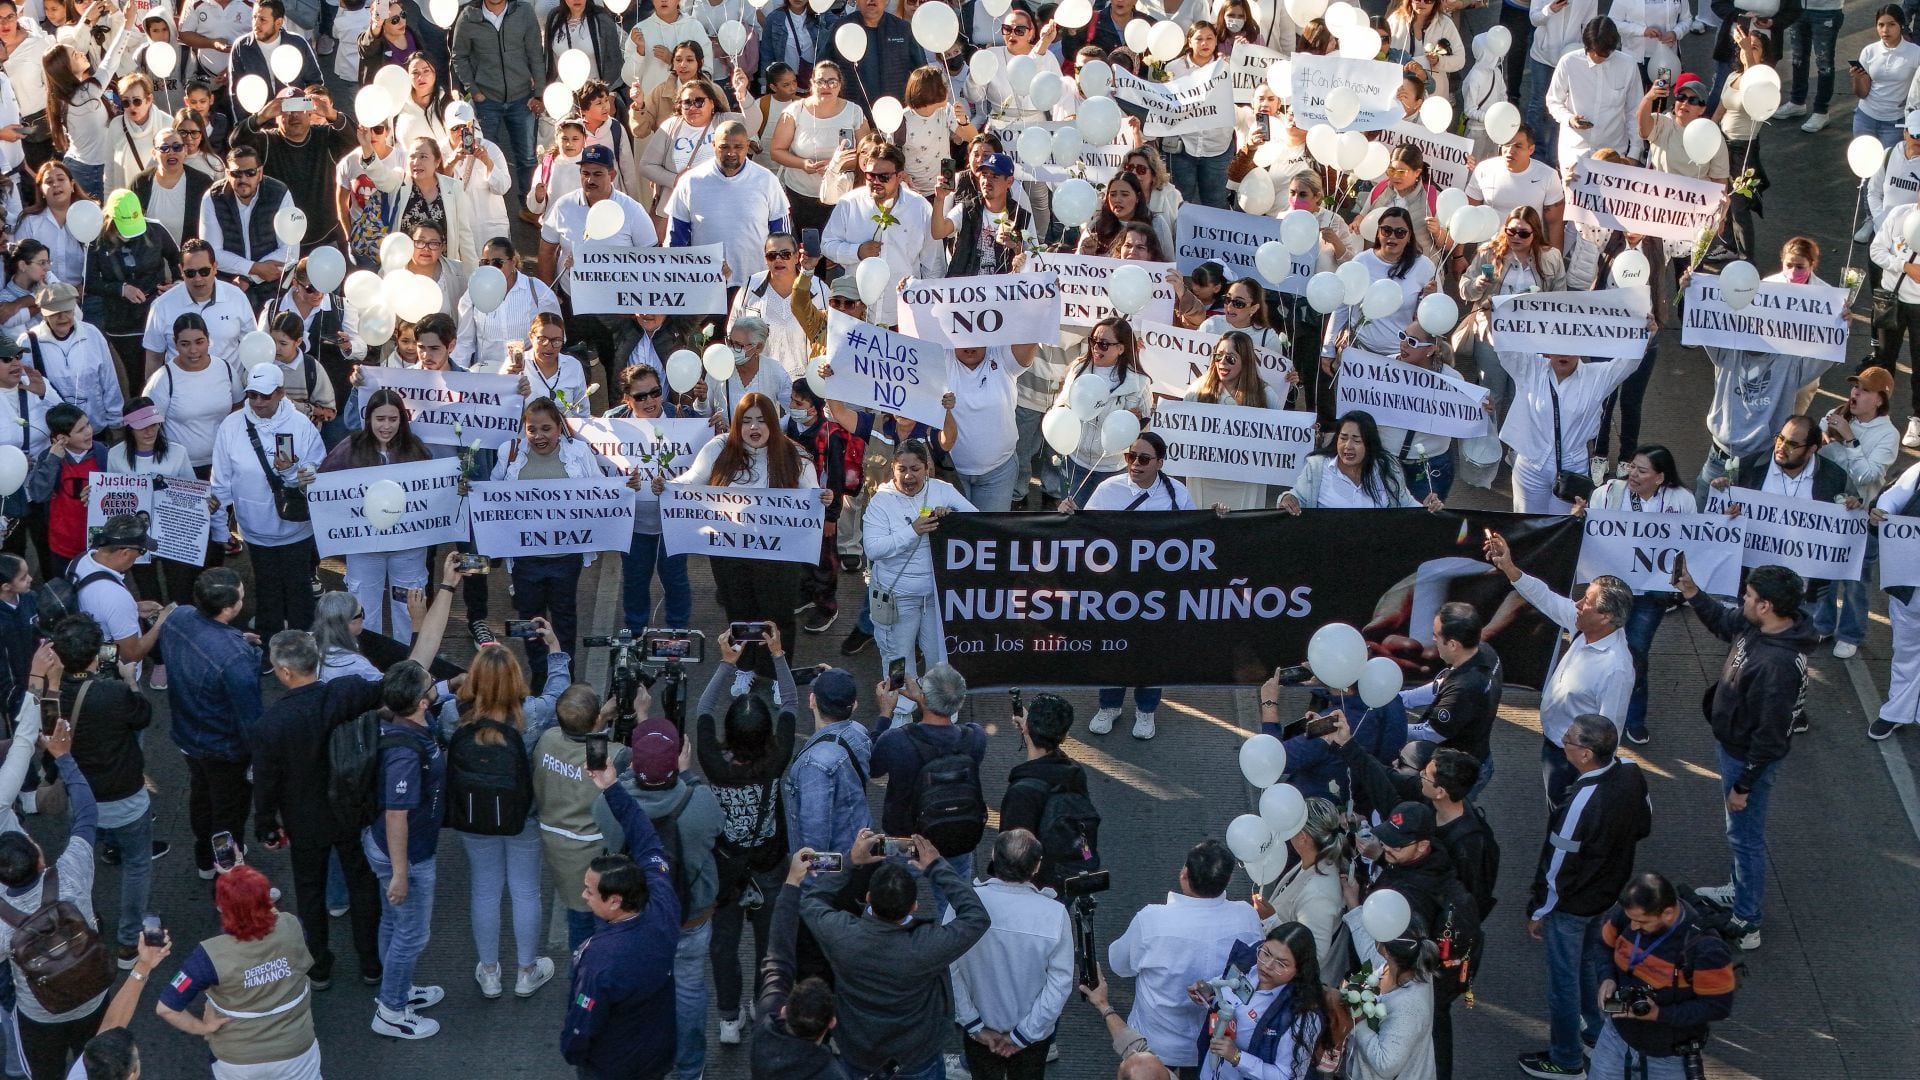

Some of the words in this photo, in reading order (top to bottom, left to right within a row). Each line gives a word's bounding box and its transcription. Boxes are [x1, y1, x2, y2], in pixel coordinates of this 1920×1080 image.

[1242, 56, 1283, 68] JUST
[1141, 97, 1164, 110] NOS
[1378, 129, 1396, 146] DE
[1086, 153, 1102, 167] SIN
[1102, 154, 1121, 168] VID
[1584, 172, 1660, 197] JUSTICIA
[1664, 187, 1707, 206] PARA
[1890, 176, 1918, 192] PUMA
[1568, 188, 1639, 220] ALEXANDER
[1642, 204, 1716, 229] SARMIENTO
[1192, 225, 1259, 247] JUSTICIA
[583, 253, 610, 264] LOS
[613, 252, 656, 264] NIÑOS
[656, 255, 667, 264] Y
[670, 254, 711, 265] NIÑAS
[1180, 245, 1215, 259] GAEL
[573, 271, 639, 282] MERECEN
[642, 272, 661, 282] UN
[664, 271, 723, 283] SINALOA
[1034, 263, 1060, 275] LOS
[1064, 264, 1107, 278] NIÑOS
[1622, 269, 1641, 278] Gael
[617, 292, 643, 306] EN
[649, 292, 686, 307] PAZ
[902, 288, 944, 305] CON
[950, 286, 987, 304] LOS
[995, 280, 1056, 302] NIÑOS
[1701, 286, 1781, 309] JUCIA
[1786, 298, 1832, 315] PARA
[1064, 302, 1090, 318] EN
[1512, 300, 1584, 314] JUSTICIA
[1589, 306, 1631, 318] PARA
[951, 309, 1004, 334] NO
[1493, 318, 1536, 334] GAEL
[1538, 321, 1549, 334] Y
[1551, 322, 1649, 340] ALEXANDER
[1686, 308, 1764, 336] ALEXANDER
[1766, 320, 1844, 346] SARMIENTO
[1145, 331, 1184, 351] CON
[1188, 340, 1213, 357] LO
[1255, 350, 1287, 372] ÑOS
[854, 354, 920, 384] NIÑOS
[1342, 361, 1364, 378] NO
[1368, 363, 1400, 384] MÁS
[1402, 370, 1461, 393] VIOLE
[458, 391, 501, 406] PARA
[874, 381, 906, 408] NO
[1341, 387, 1356, 402] NO
[1358, 386, 1381, 407] MÁS
[1383, 393, 1437, 415] INFANCIAS
[1439, 402, 1456, 418] SIN
[1457, 404, 1483, 421] VIDA
[417, 408, 519, 432] ALEXANDER
[1152, 411, 1198, 432] BASTA
[1201, 416, 1221, 434] DE
[1222, 419, 1312, 443] ASESINATOS
[589, 442, 646, 457] STICIA
[650, 442, 693, 456] PARA
[1252, 451, 1296, 469] VIVIR!
[96, 474, 148, 488] Justicia
[307, 483, 369, 503] CULIACÁ
[412, 479, 430, 492] DE
[104, 500, 136, 508] ALEXIS
[483, 491, 512, 502] LOS
[515, 488, 560, 502] NIÑOS
[563, 490, 575, 500] Y
[576, 486, 620, 500] NIÑAS
[674, 490, 702, 501] LOS
[706, 492, 752, 504] NIÑOS
[754, 496, 766, 505] Y
[766, 496, 811, 511] NIÑAS
[103, 508, 137, 516] RAMOS
[405, 499, 428, 514] TAN
[473, 508, 543, 523] MERECEN
[547, 509, 567, 520] UN
[570, 506, 632, 520] SINALOA
[663, 508, 732, 522] MERECEN
[736, 512, 756, 525] UN
[760, 514, 822, 529] SINALOA
[1756, 505, 1777, 523] DE
[1779, 509, 1867, 535] ASESINATOS
[328, 527, 362, 540] GAEL
[363, 525, 372, 537] Y
[520, 531, 547, 547] EN
[554, 529, 593, 546] PAZ
[709, 531, 736, 547] EN
[742, 533, 782, 551] PAZ
[1586, 519, 1628, 537] CON
[1632, 522, 1671, 539] LOS
[1680, 522, 1741, 544] NIÑOS
[946, 538, 997, 571] DE
[1009, 538, 1119, 573] LUTO
[1130, 538, 1218, 572] POR
[1744, 532, 1804, 557] EREMOS
[1807, 542, 1852, 563] VIVIR!
[944, 588, 1166, 622] NUESTROS
[1177, 577, 1313, 621] NIÑOS
[943, 635, 984, 655] Con
[994, 634, 1024, 651] los
[1033, 635, 1092, 651] niños
[1102, 638, 1128, 650] no
[542, 753, 582, 781] PRENSA
[244, 966, 292, 989] HUMANOS
[245, 957, 288, 980] DERECHOS
